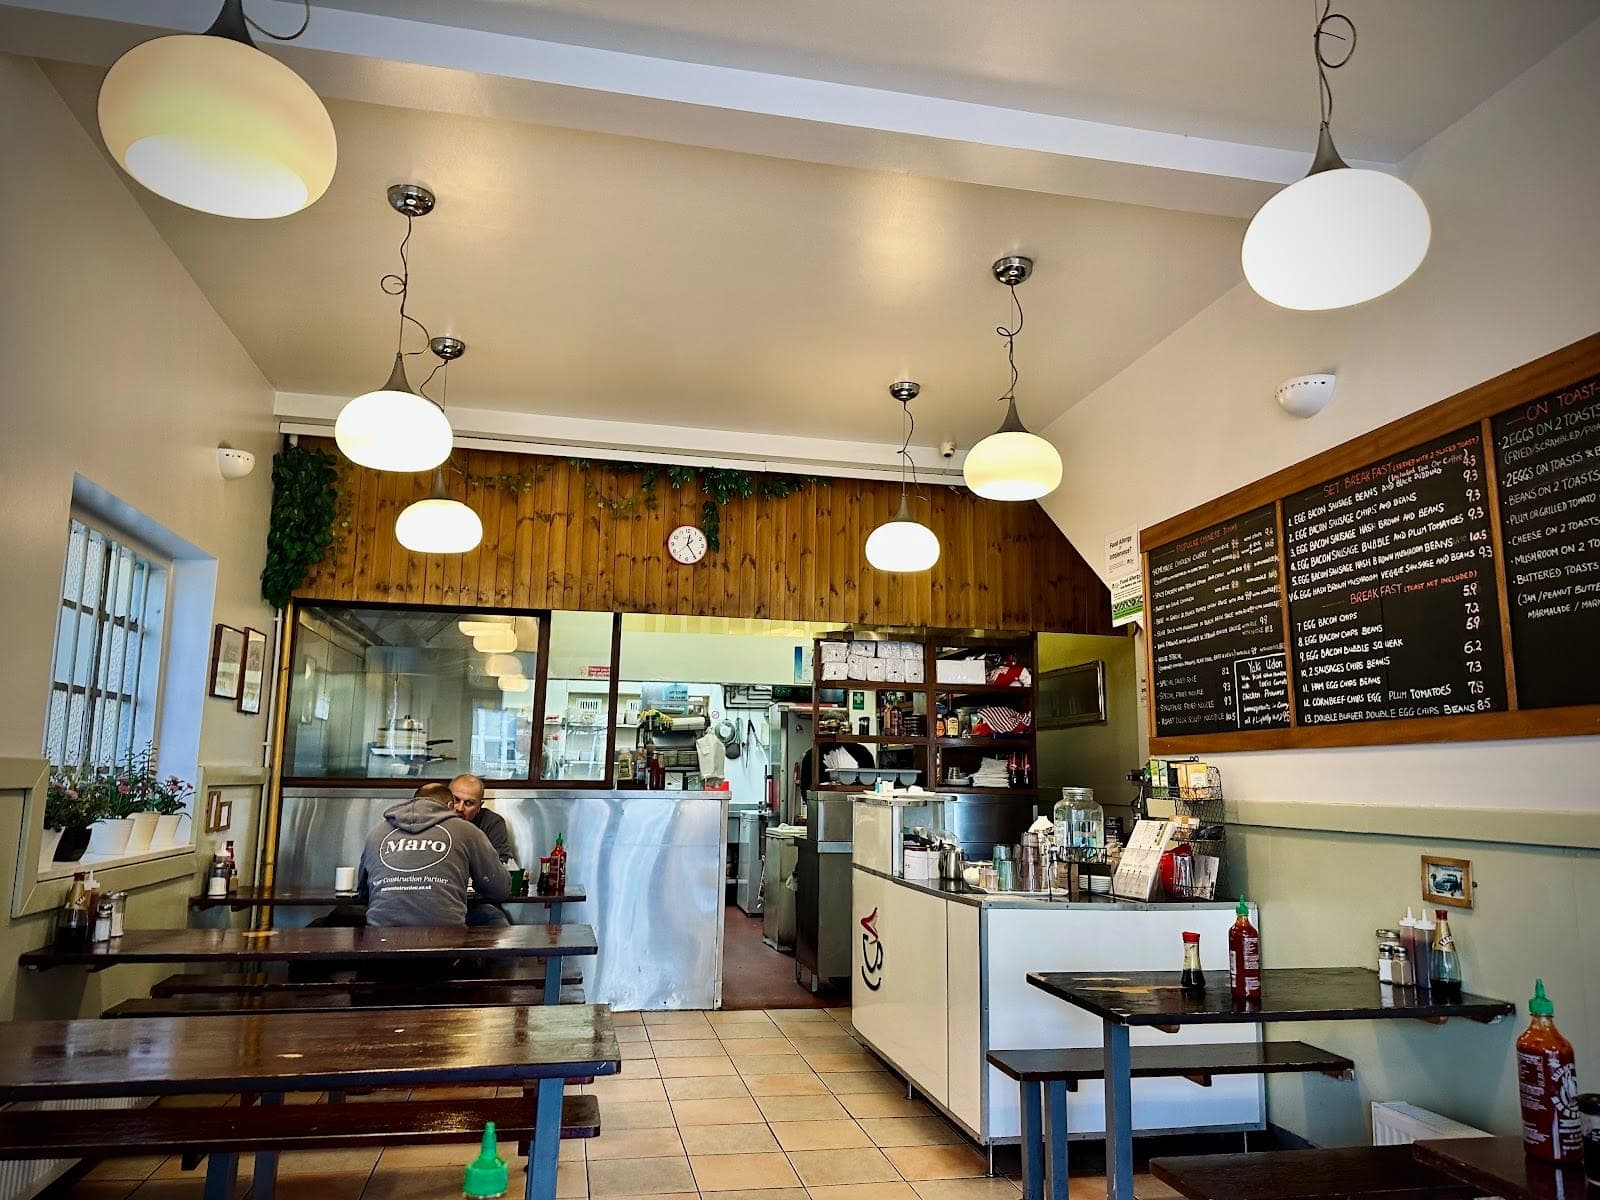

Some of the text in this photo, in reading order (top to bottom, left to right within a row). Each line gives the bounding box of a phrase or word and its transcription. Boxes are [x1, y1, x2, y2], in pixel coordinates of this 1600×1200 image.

[1526, 382, 1597, 421] ON TOAST
[1536, 419, 1552, 436] ON
[1554, 417, 1562, 431] 2
[1388, 460, 1442, 483] (Included Tea Or
[1536, 461, 1549, 476] ON
[1550, 451, 1584, 472] TOASTS
[1324, 482, 1340, 498] SET
[1344, 462, 1392, 488] BREAKFAST
[1508, 469, 1600, 506] BEANS ON 2 TOASTS
[1308, 505, 1326, 520] BACON
[1328, 496, 1353, 512] SAUSAGE
[1354, 487, 1378, 502] BEANS
[1382, 481, 1394, 492] AND
[1308, 522, 1328, 536] BACON
[1328, 512, 1354, 528] SAUSAGE
[1356, 504, 1378, 520] CHIPS
[1379, 500, 1392, 510] AND
[1393, 492, 1417, 506] BEANS
[1463, 469, 1478, 482] 9.3
[1510, 493, 1597, 526] PLUM OR GRILLED TOMATO
[1310, 536, 1329, 552] BACON
[1330, 528, 1356, 544] SAUSAGE
[1358, 522, 1376, 535] HASH
[1378, 514, 1400, 530] BROWN
[1402, 512, 1416, 522] AND
[1418, 502, 1445, 518] BEANS
[1466, 488, 1481, 502] 9.3
[1512, 516, 1600, 546] CHEESE ON 2 TOASTS
[1310, 552, 1332, 568] BACON
[1331, 544, 1359, 560] SAUSAGE
[1361, 535, 1390, 553] BUBBLE
[1393, 531, 1406, 541] AND
[1408, 525, 1427, 538] PLUM
[1427, 514, 1464, 532] TOMATOES
[1467, 506, 1484, 520] 9.3
[1310, 569, 1329, 582] BACON
[1328, 564, 1354, 576] SAUSAGE
[1355, 558, 1372, 570] HASH
[1372, 553, 1394, 566] BROWN
[1394, 545, 1424, 560] MUSHROOM
[1424, 538, 1453, 552] BEANS
[1469, 530, 1488, 542] 10.5
[1514, 547, 1559, 565] MUSHROOM
[1561, 544, 1576, 555] ON
[1578, 542, 1585, 552] 2
[1312, 586, 1326, 596] HASH
[1327, 580, 1347, 592] BROWN
[1348, 574, 1378, 586] MUSHROOM
[1381, 566, 1404, 580] VEGGIE
[1405, 560, 1434, 573] SAUSAGE
[1436, 554, 1450, 564] AND
[1450, 549, 1476, 562] BEANS
[1478, 546, 1492, 558] 9.3
[1516, 562, 1600, 585] BUTTERED TOASTS
[1350, 584, 1402, 604] BREAKFAST
[1440, 570, 1478, 584] INCLUDED)
[1304, 619, 1316, 630] EGG
[1318, 616, 1338, 628] BACON
[1339, 612, 1358, 622] CHIPS
[1462, 582, 1478, 597] 5.9
[1528, 604, 1571, 620] MARMALADE
[1304, 634, 1317, 646] EGG
[1319, 632, 1340, 644] BACON
[1340, 628, 1358, 639] CHIPS
[1361, 624, 1383, 636] BEANS
[1306, 650, 1318, 661] EGG
[1320, 646, 1342, 659] BACON
[1344, 644, 1370, 654] BUBBLE
[1308, 667, 1314, 678] 2
[1314, 663, 1344, 676] SAUSAGES
[1346, 662, 1364, 672] CHIPS
[1366, 656, 1391, 669] BEANS
[1464, 640, 1482, 654] 6.2
[1326, 680, 1338, 690] EGG
[1340, 679, 1358, 688] CHIPS
[1360, 676, 1381, 686] BEANS
[1466, 661, 1482, 673] 7.3
[1312, 684, 1452, 708] CORNBEEF CHIPS EGG PLUM TOMATOES
[1314, 712, 1338, 724] DOUBLE
[1338, 710, 1364, 720] BURGER
[1366, 708, 1396, 720] DOUBLE
[1398, 707, 1416, 717] EGG
[1416, 706, 1440, 716] CHIPS
[1444, 704, 1476, 714] BEANS
[384, 838, 446, 854] Maro
[384, 874, 422, 884] Construction
